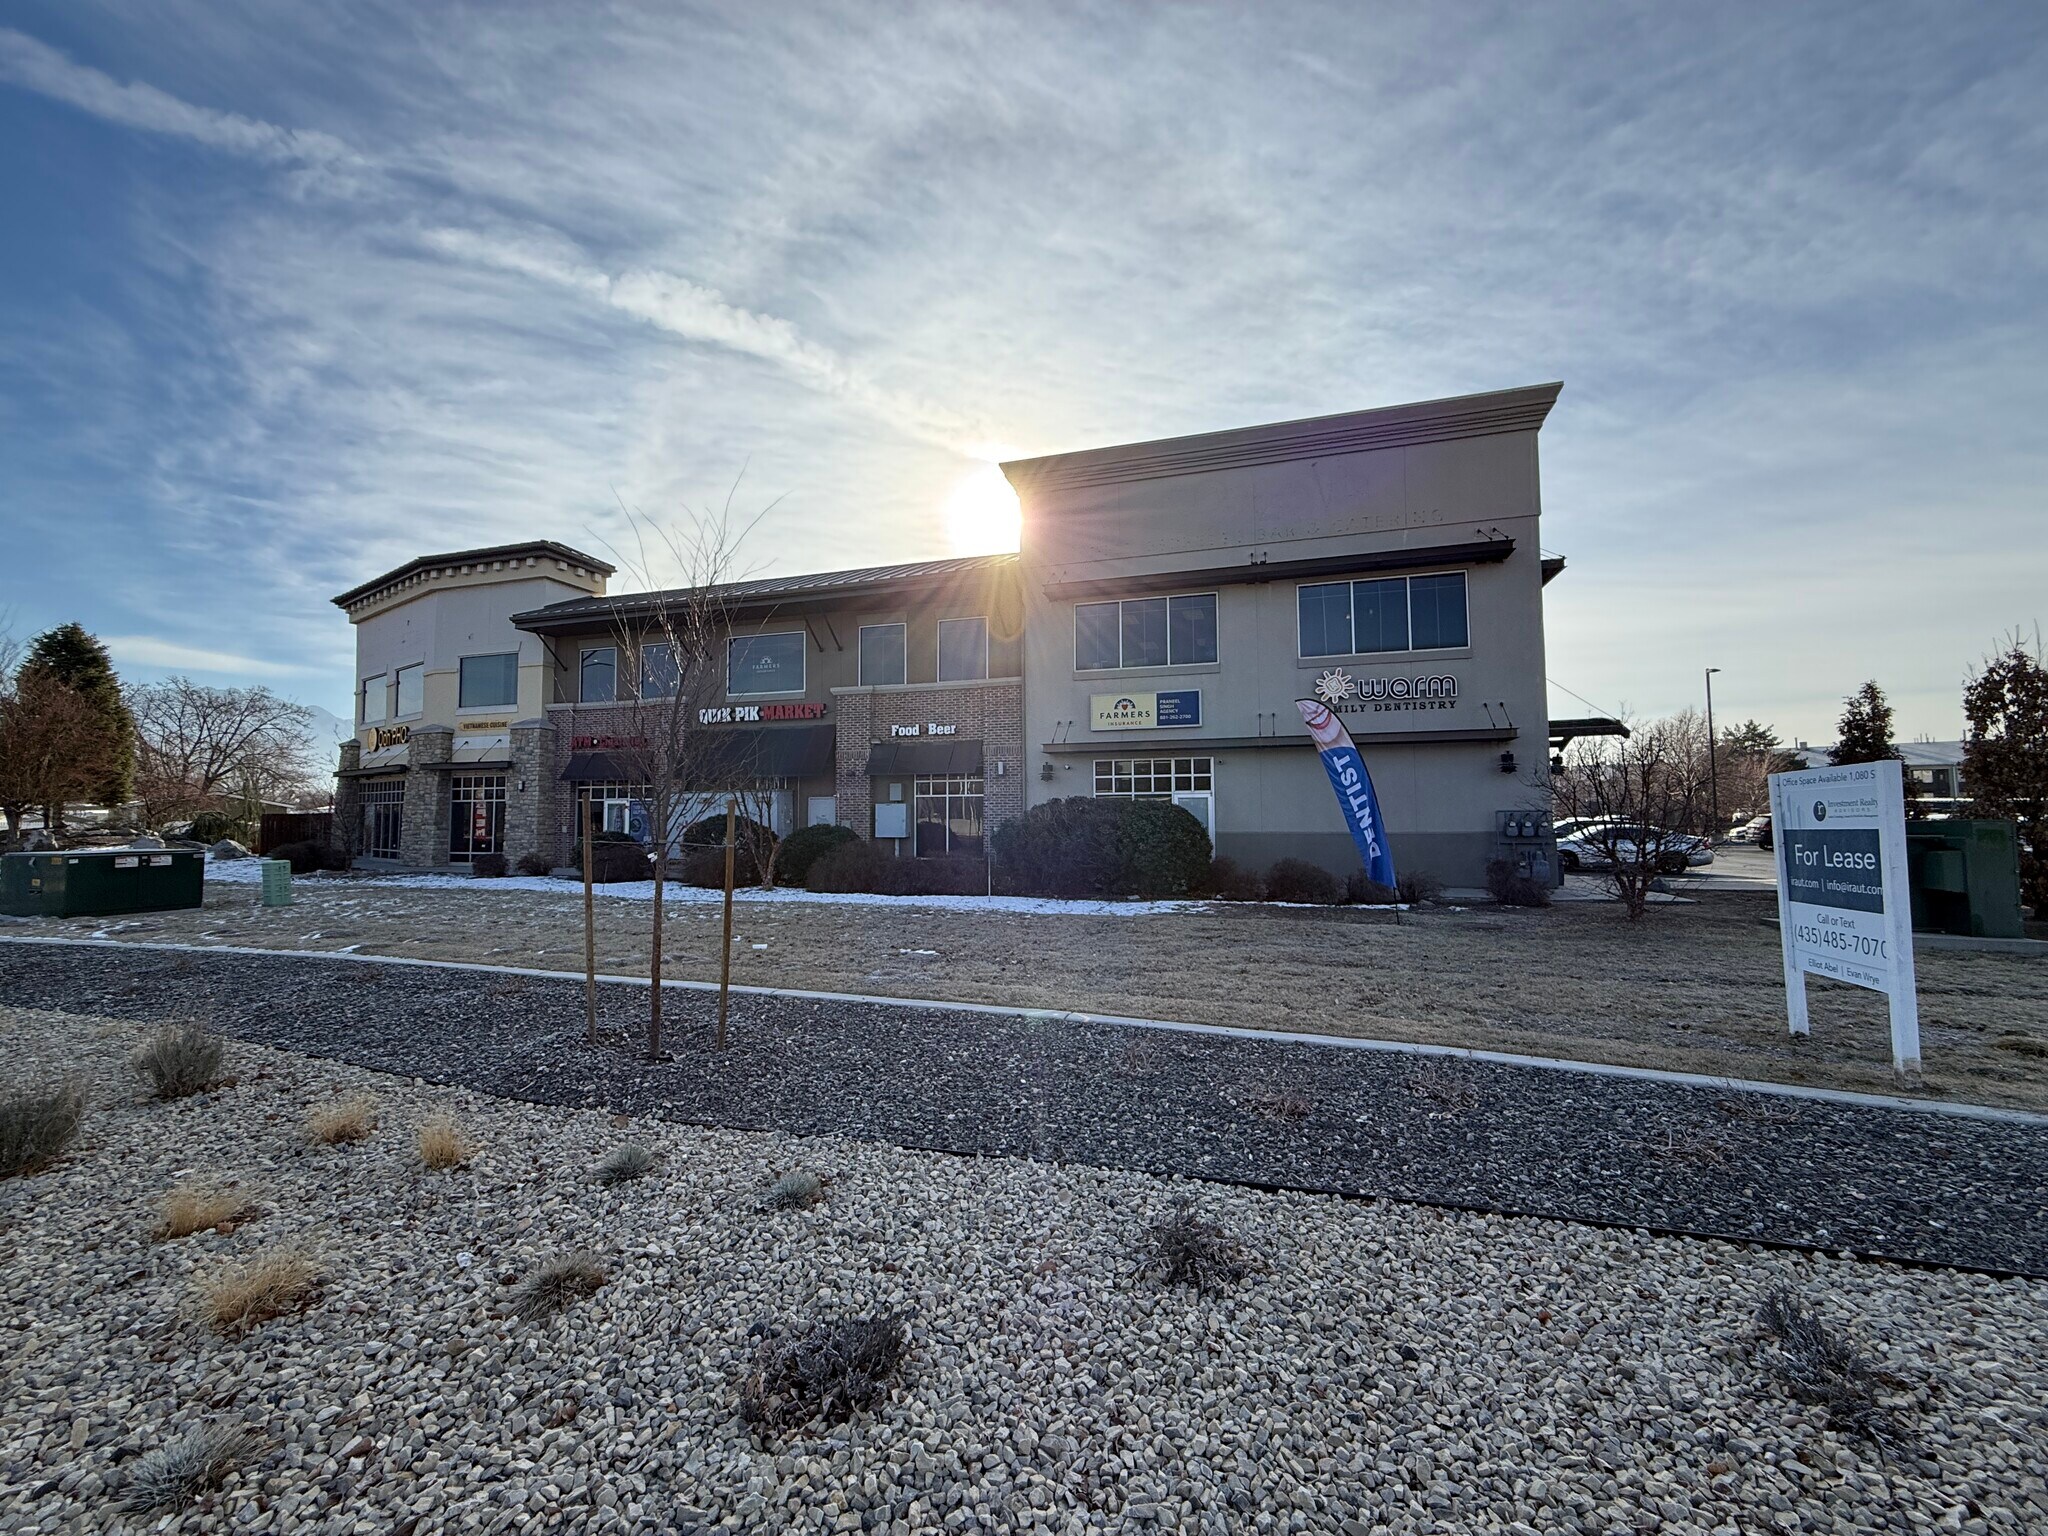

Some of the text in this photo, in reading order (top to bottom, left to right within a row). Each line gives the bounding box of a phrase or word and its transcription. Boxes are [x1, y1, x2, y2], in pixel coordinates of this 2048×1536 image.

[1358, 674, 1458, 701] warm
[735, 706, 760, 721] PIK
[763, 703, 826, 720] MARKET
[1334, 700, 1457, 713] MILY DENTISTRY
[1100, 710, 1151, 720] FARMERS
[891, 723, 957, 736] Food Beer
[1782, 778, 1798, 787] Office
[1800, 777, 1817, 787] Space
[1818, 773, 1848, 783] Available
[1333, 755, 1381, 861] DENTIST
[1795, 844, 1876, 870] For Lease
[1790, 876, 1820, 889] iraut.com
[1816, 913, 1856, 929] Call or Text
[1824, 962, 1838, 973] Abel
[1846, 967, 1862, 979] Evan
